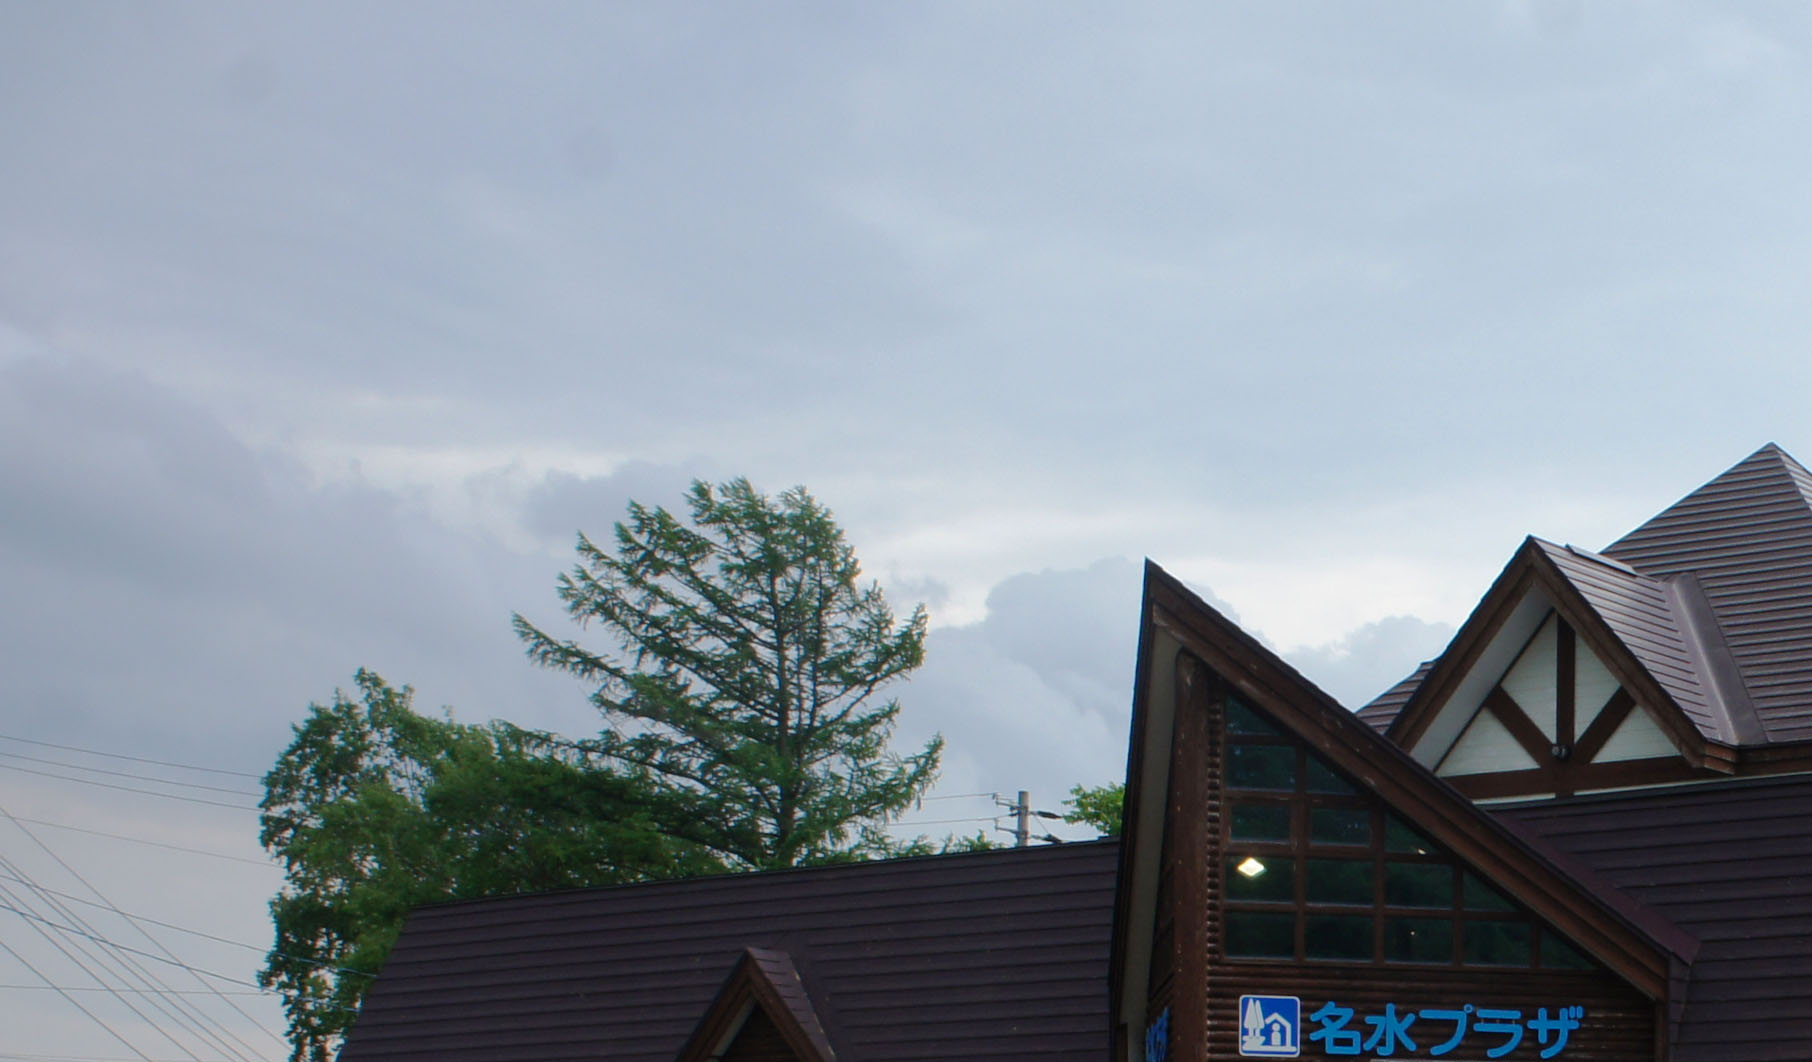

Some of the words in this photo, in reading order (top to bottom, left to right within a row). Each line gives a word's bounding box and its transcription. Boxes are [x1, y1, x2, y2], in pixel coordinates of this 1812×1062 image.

[1309, 1001, 1584, 1059] 名水プラザ
